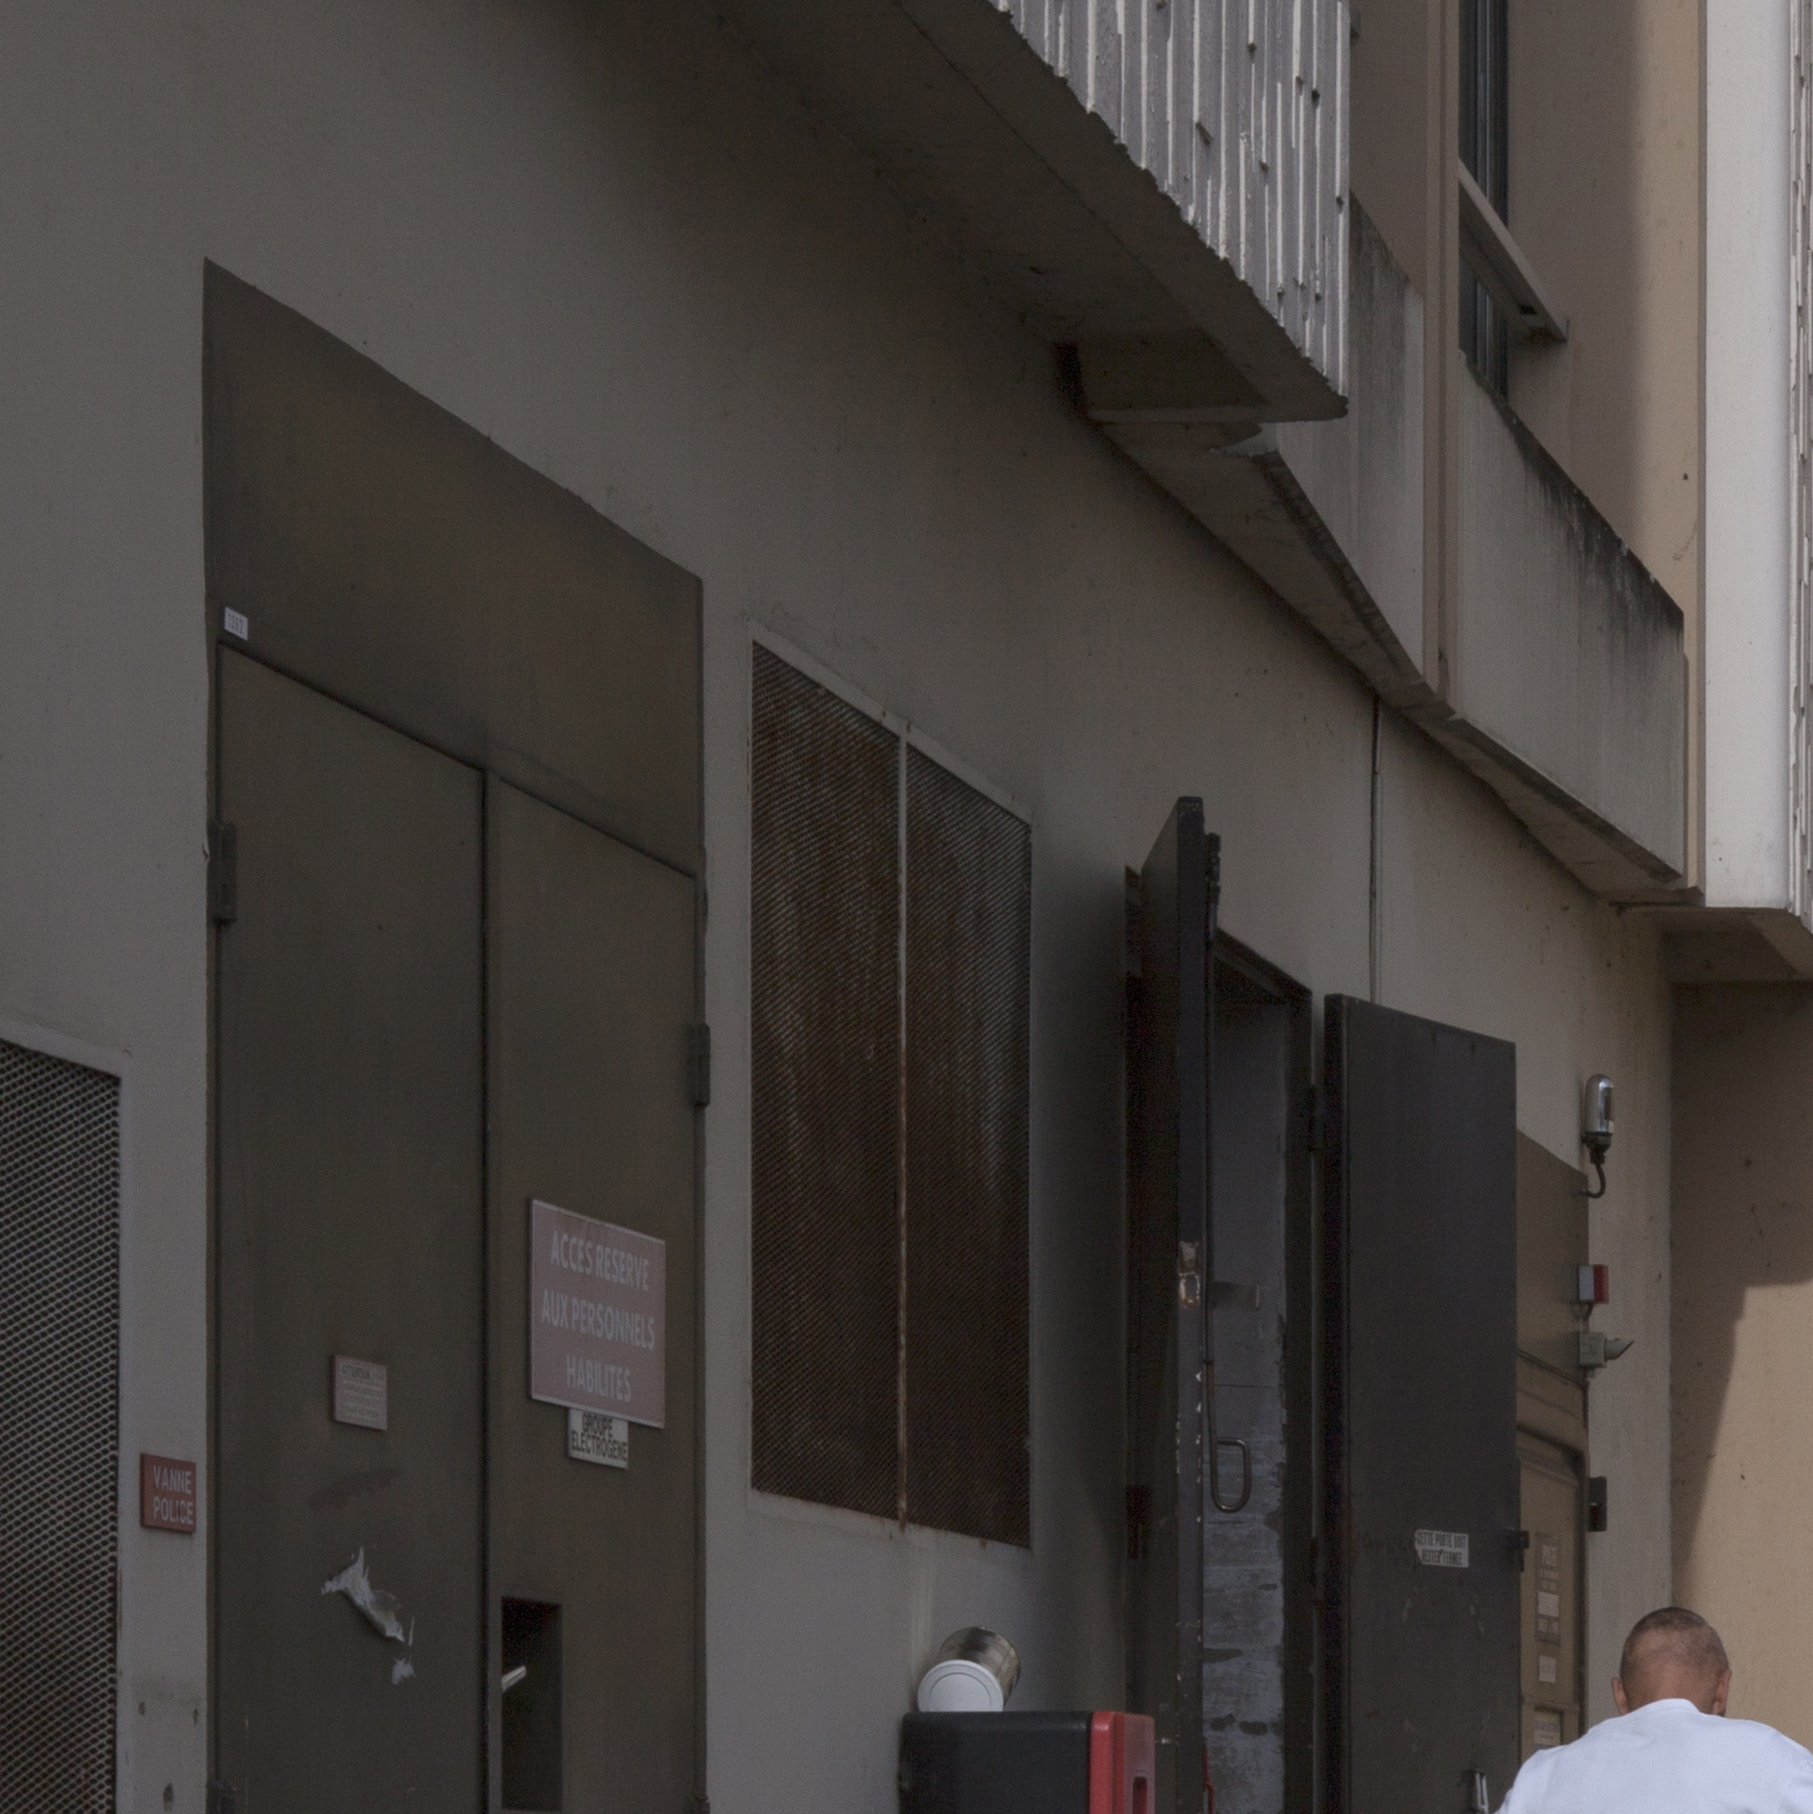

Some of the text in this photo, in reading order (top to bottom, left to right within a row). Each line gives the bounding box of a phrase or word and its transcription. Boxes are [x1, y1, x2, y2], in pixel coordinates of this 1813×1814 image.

[550, 1230, 650, 1292] ACCES RESERVE
[541, 1288, 656, 1350] AUX PERSONNELS
[566, 1353, 632, 1402] HABILITES
[582, 1411, 613, 1438] GROUPE
[571, 1430, 628, 1462] ELECTROGENE
[153, 1465, 192, 1494] VANNE
[153, 1496, 194, 1525] POLICE
